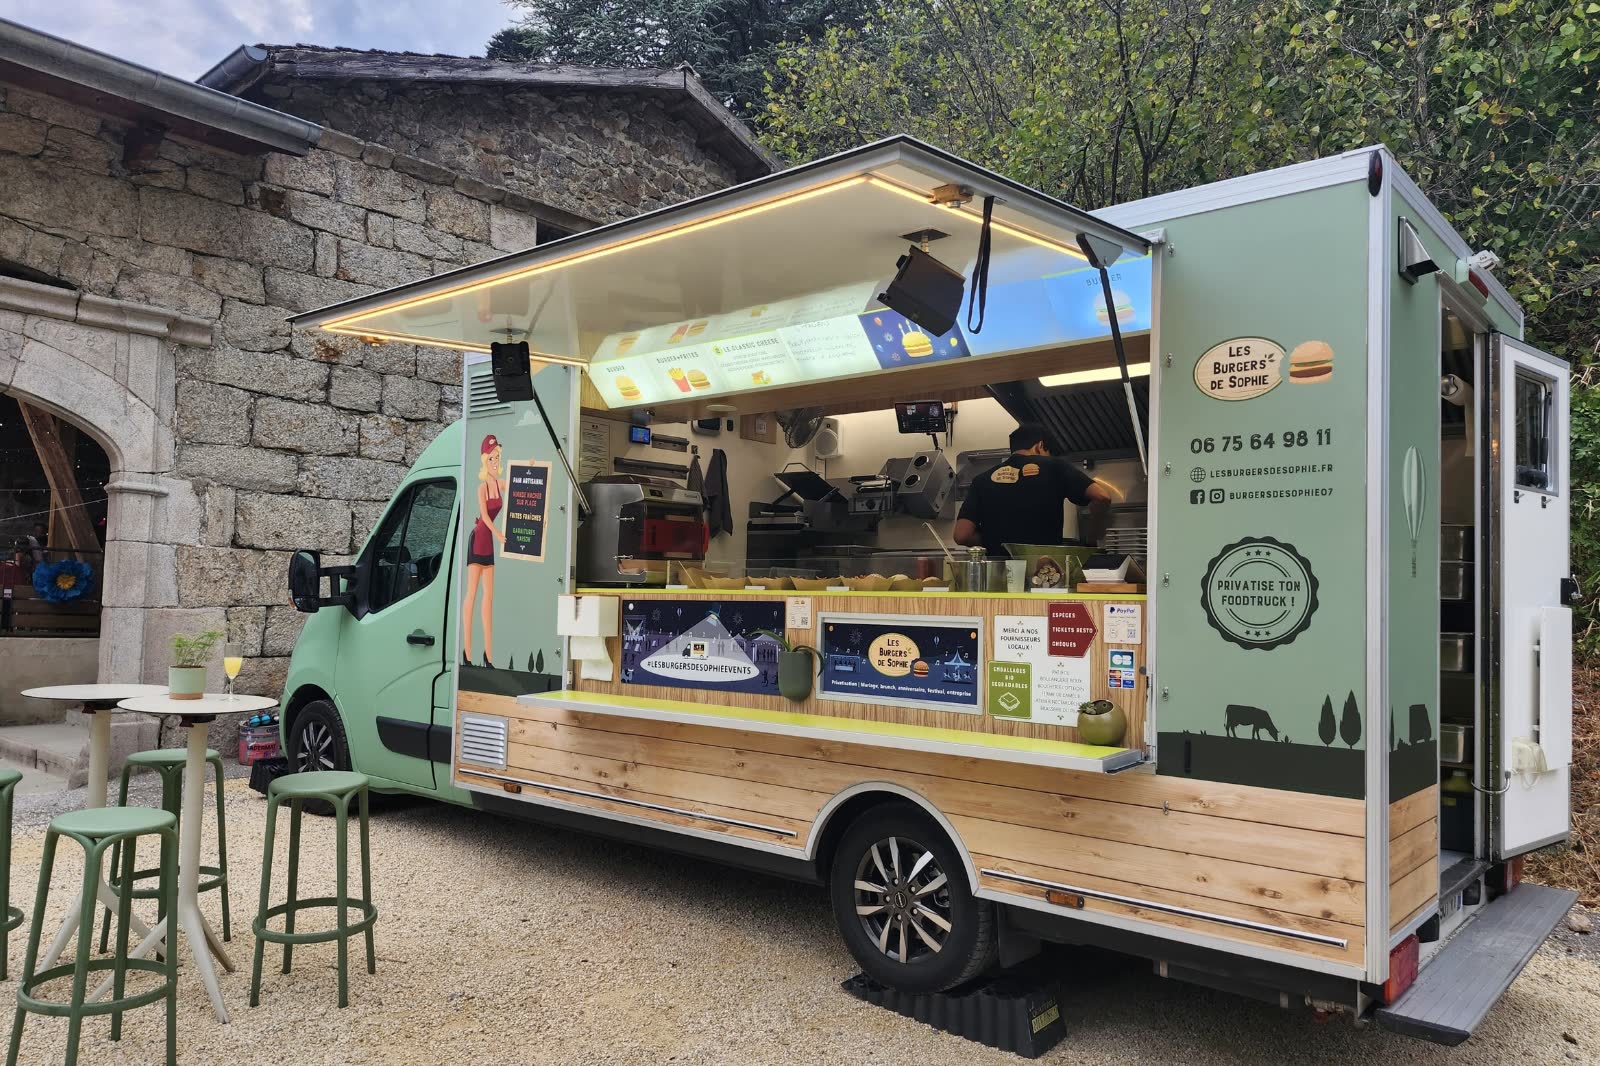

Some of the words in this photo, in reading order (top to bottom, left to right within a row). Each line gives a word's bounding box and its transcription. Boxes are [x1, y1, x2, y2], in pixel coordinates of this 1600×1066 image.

[1086, 273, 1122, 287] BUER
[1228, 346, 1251, 358] LES
[1213, 359, 1266, 375] BURGERS
[1210, 380, 1224, 390] DE
[1228, 375, 1269, 389] SOPHIE
[1190, 437, 1215, 454] 06
[1222, 435, 1243, 452] 75
[1250, 432, 1275, 450] 64
[1283, 430, 1309, 448] 98
[1316, 428, 1331, 446] 11
[1210, 463, 1333, 478] LESBURGERSDESOPHIE.FR
[1229, 488, 1334, 500] BURGERSDESOPHIE07
[1217, 580, 1275, 591] PRIVATISE
[1279, 581, 1301, 592] TON
[1221, 595, 1287, 607] FOODTRUCK
[887, 638, 900, 647] LES
[1000, 635, 1041, 643] FOURNISSEURS
[879, 647, 908, 658] BURGERS
[647, 660, 751, 675] #LESBURGERSDESOPHIEEVENTS
[877, 659, 886, 667] DE
[887, 658, 909, 668] SOPHIE
